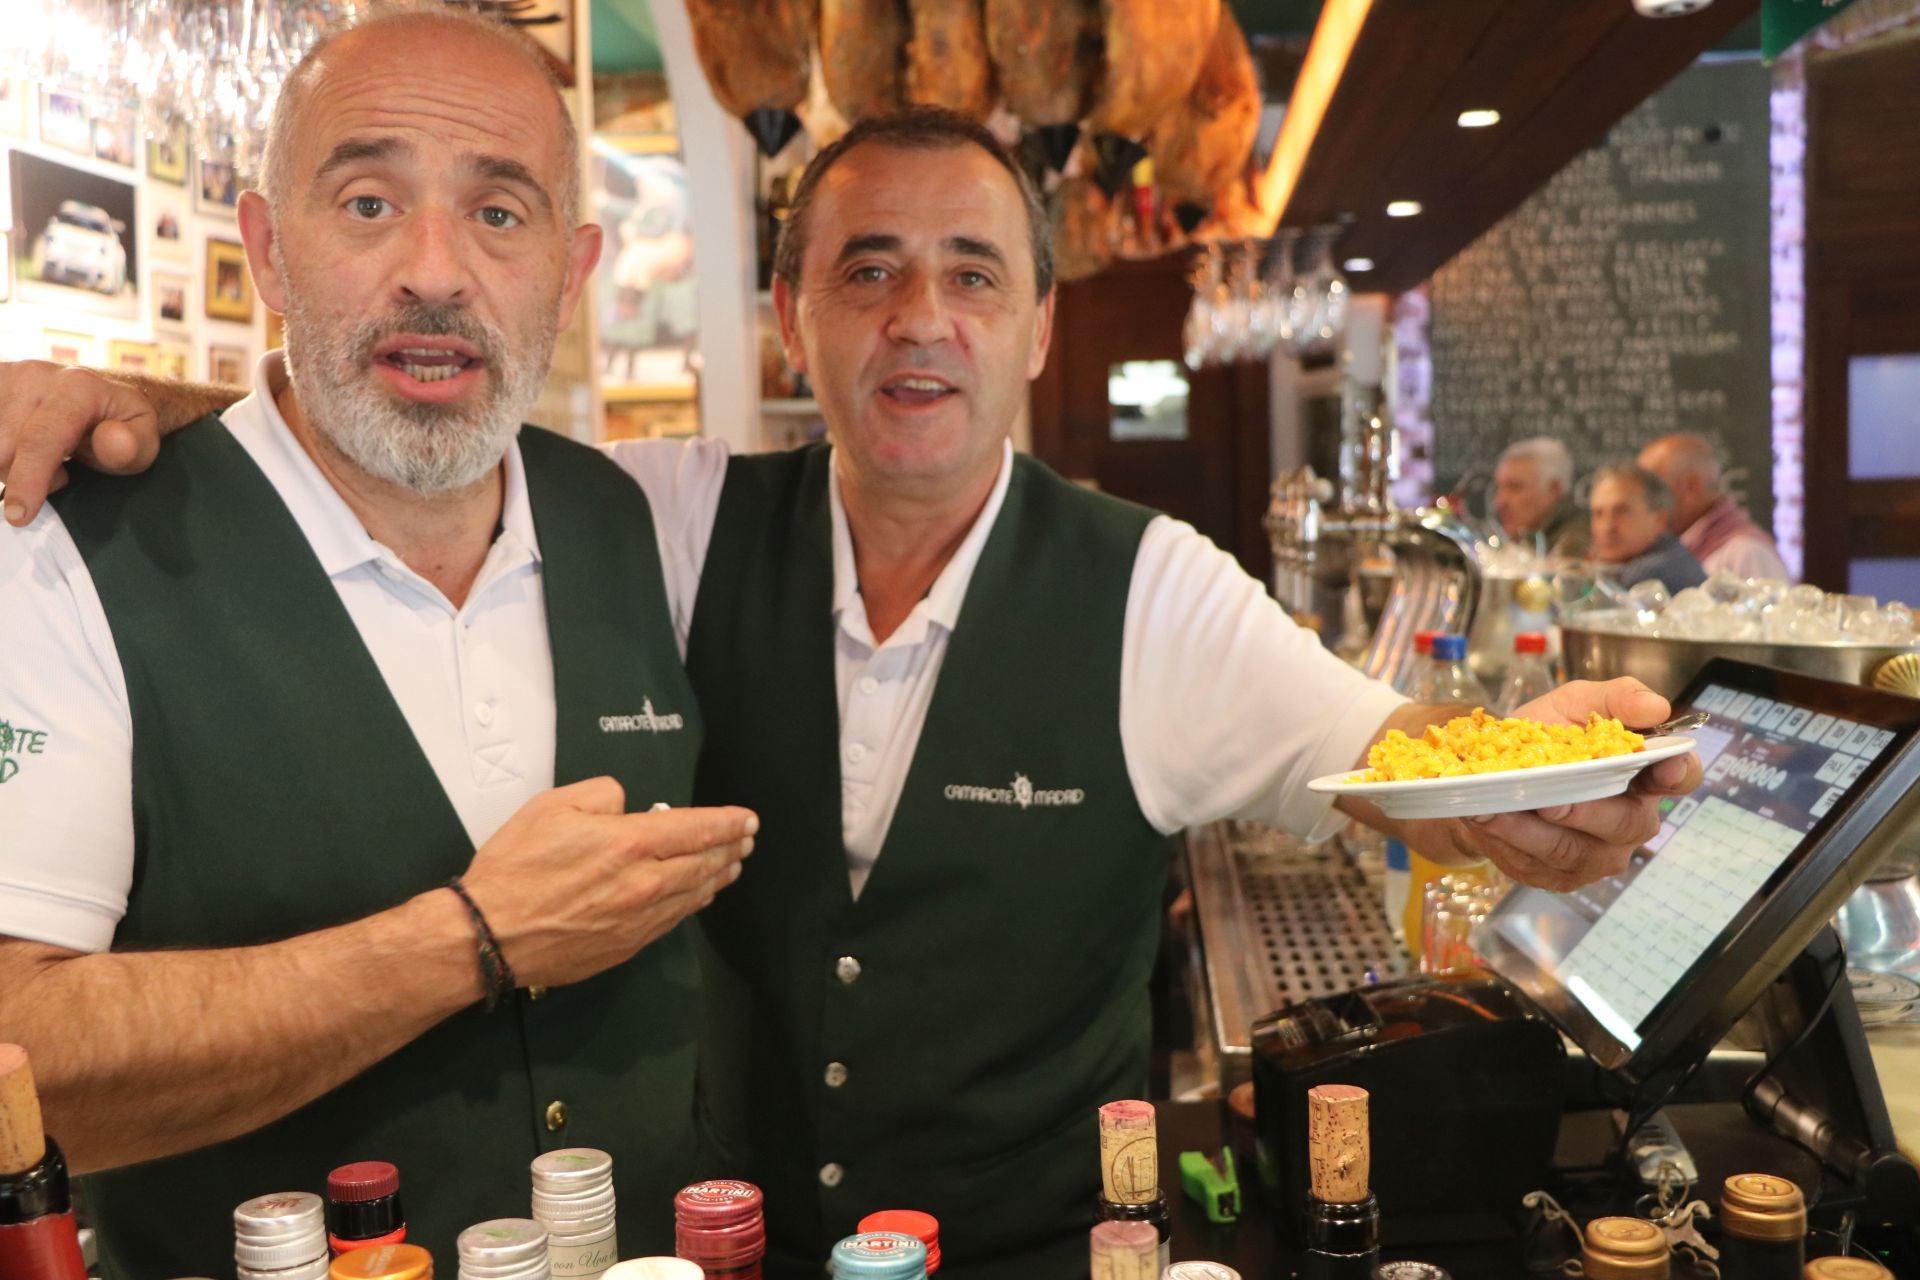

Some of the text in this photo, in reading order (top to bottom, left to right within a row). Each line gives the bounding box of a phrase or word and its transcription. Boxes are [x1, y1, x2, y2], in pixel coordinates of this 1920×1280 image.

[944, 784, 1085, 805] CAMAROTE MADRID
[686, 1186, 752, 1197] MARTINI
[844, 1240, 917, 1249] MARTINI
